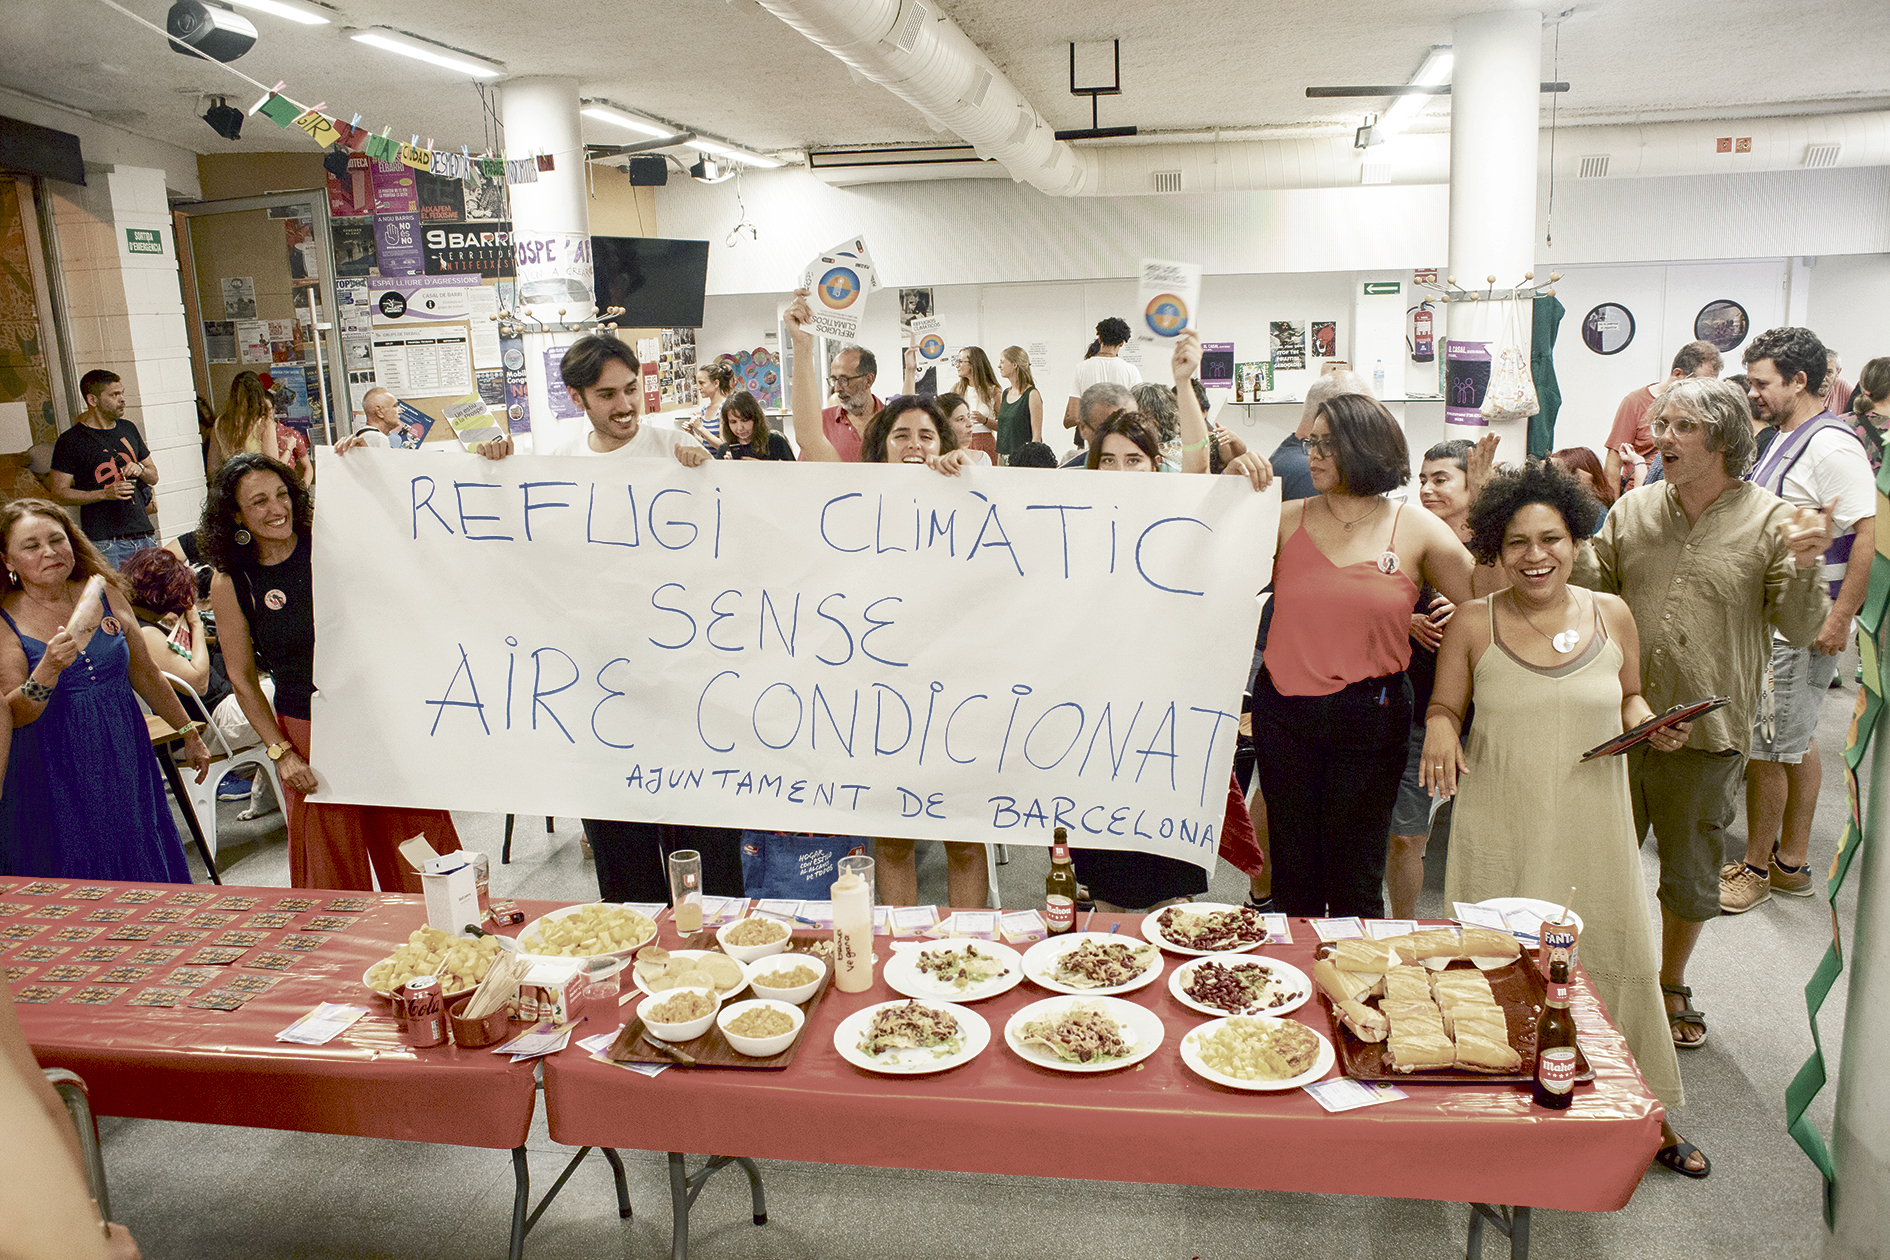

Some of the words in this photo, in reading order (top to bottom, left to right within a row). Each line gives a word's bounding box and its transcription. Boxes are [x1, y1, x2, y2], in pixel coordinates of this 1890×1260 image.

[420, 204, 452, 213] AIXAFEM
[399, 222, 411, 230] NO
[401, 237, 413, 245] NO
[371, 279, 394, 287] ESPAI
[395, 278, 424, 287] LLIURE
[424, 276, 480, 286] D'AGRESSIONS
[811, 315, 857, 331] CLIMATICOS
[815, 324, 856, 339] REFUGIOS
[453, 409, 464, 419] Un
[464, 405, 484, 420] Prospe
[648, 582, 909, 667] SENSE
[625, 763, 871, 811] AJUNTAMENT
[896, 785, 949, 820] DE
[986, 794, 1217, 856] BARCELONA
[798, 849, 826, 862] HOGAR
[1544, 931, 1575, 945] FANTA
[407, 997, 440, 1018] Cola
